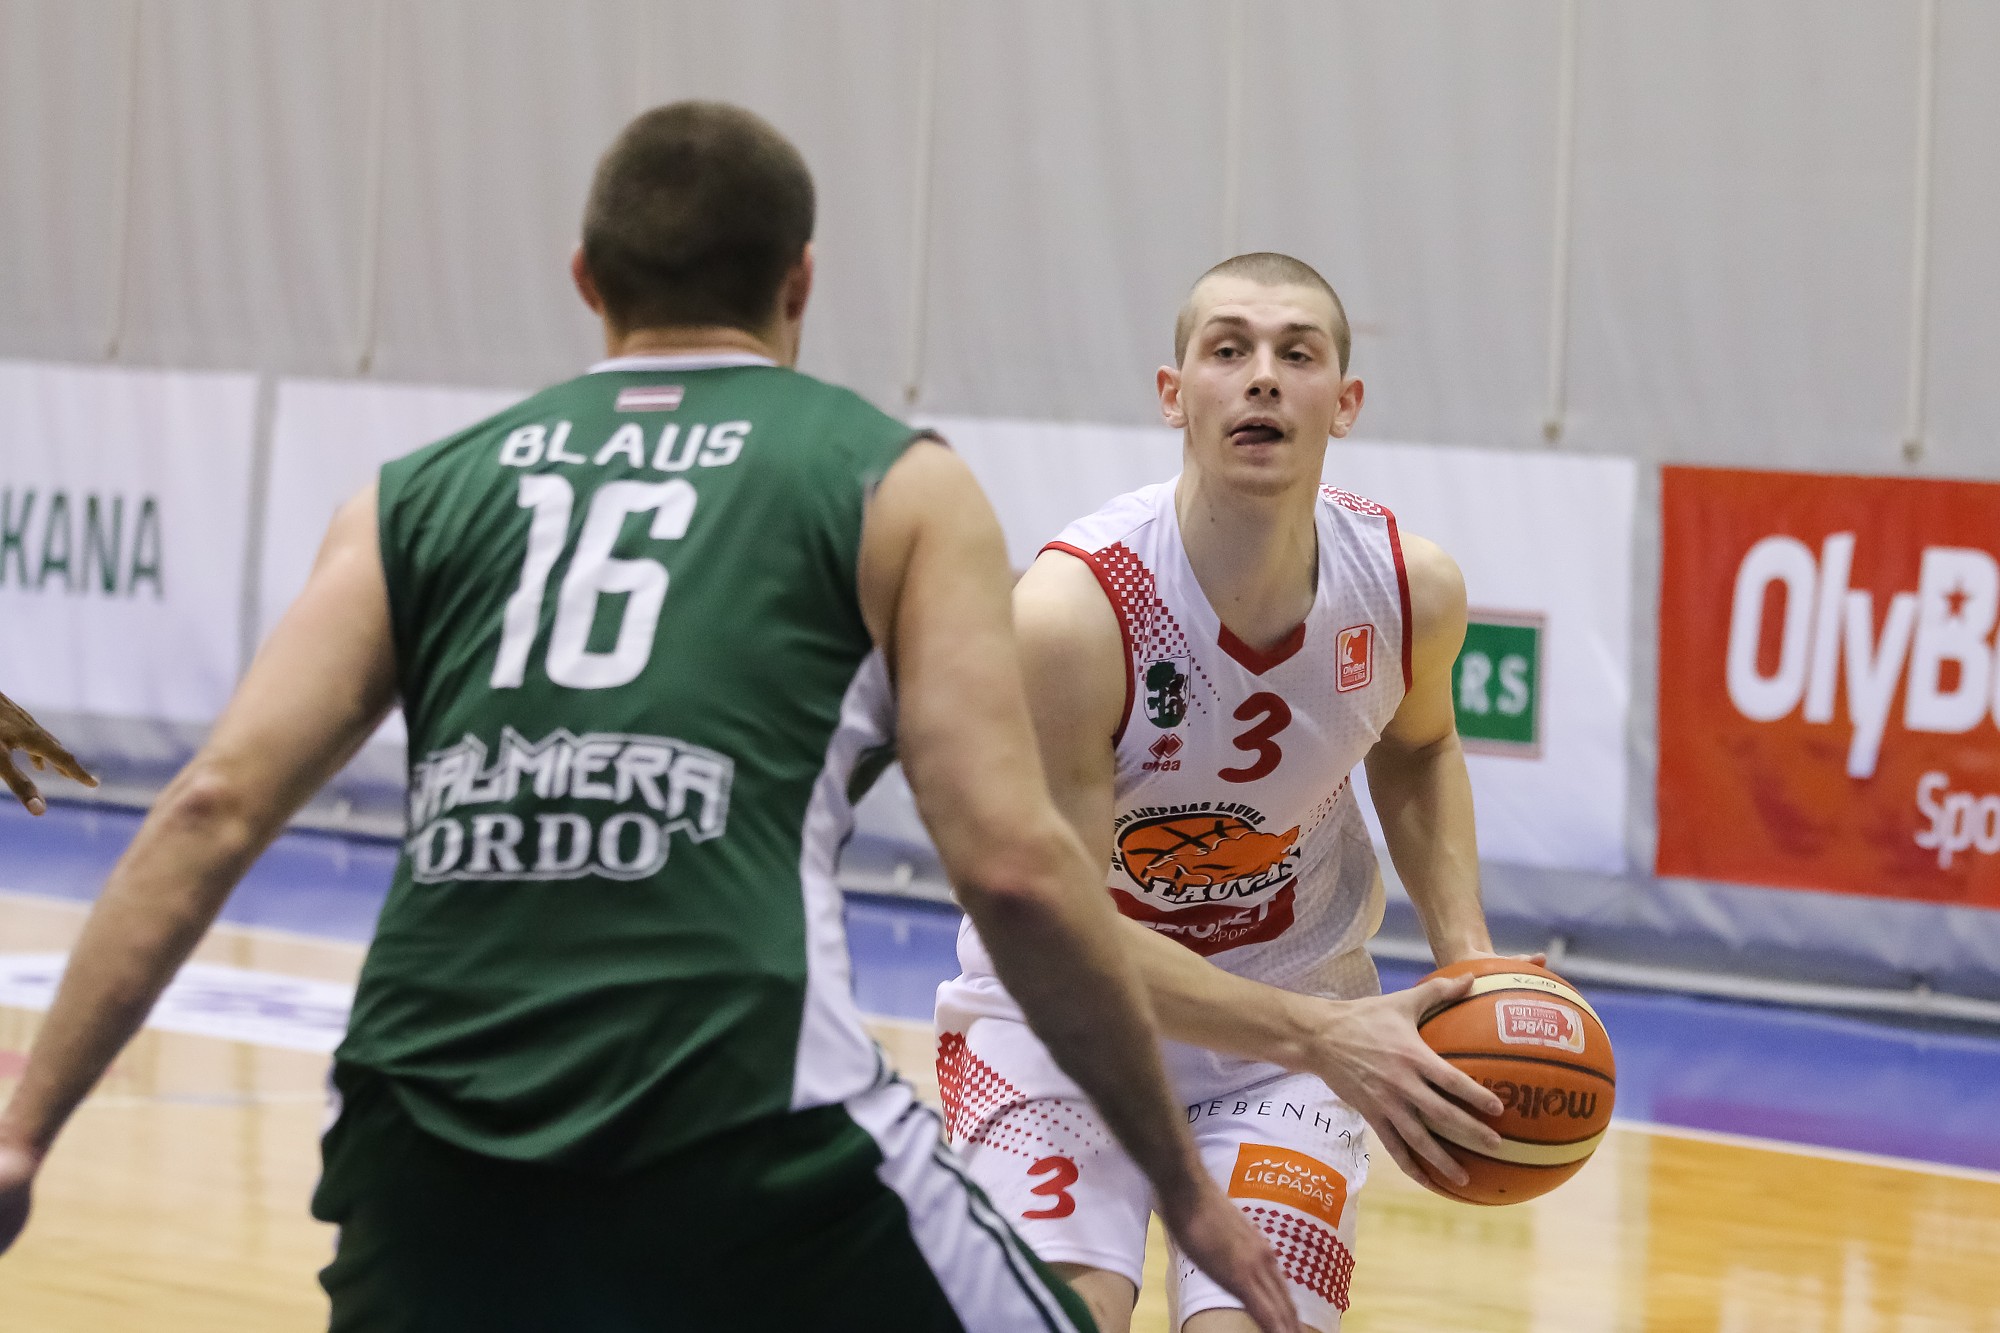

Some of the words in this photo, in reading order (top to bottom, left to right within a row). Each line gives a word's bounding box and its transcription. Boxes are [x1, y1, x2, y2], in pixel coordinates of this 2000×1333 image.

[499, 420, 752, 472] BLAUS
[0, 484, 165, 602] KANA
[490, 473, 698, 689] 16
[1459, 652, 1529, 717] RS
[1726, 531, 2000, 779] OlyB
[1217, 692, 1293, 784] 3
[411, 813, 662, 874] ORDO
[1216, 801, 1266, 826] LAUVAS
[1511, 1019, 1558, 1038] OlyBet
[1469, 1076, 1597, 1120] molte
[1187, 1100, 1371, 1169] DEBENHA
[1022, 1156, 1080, 1219] 3
